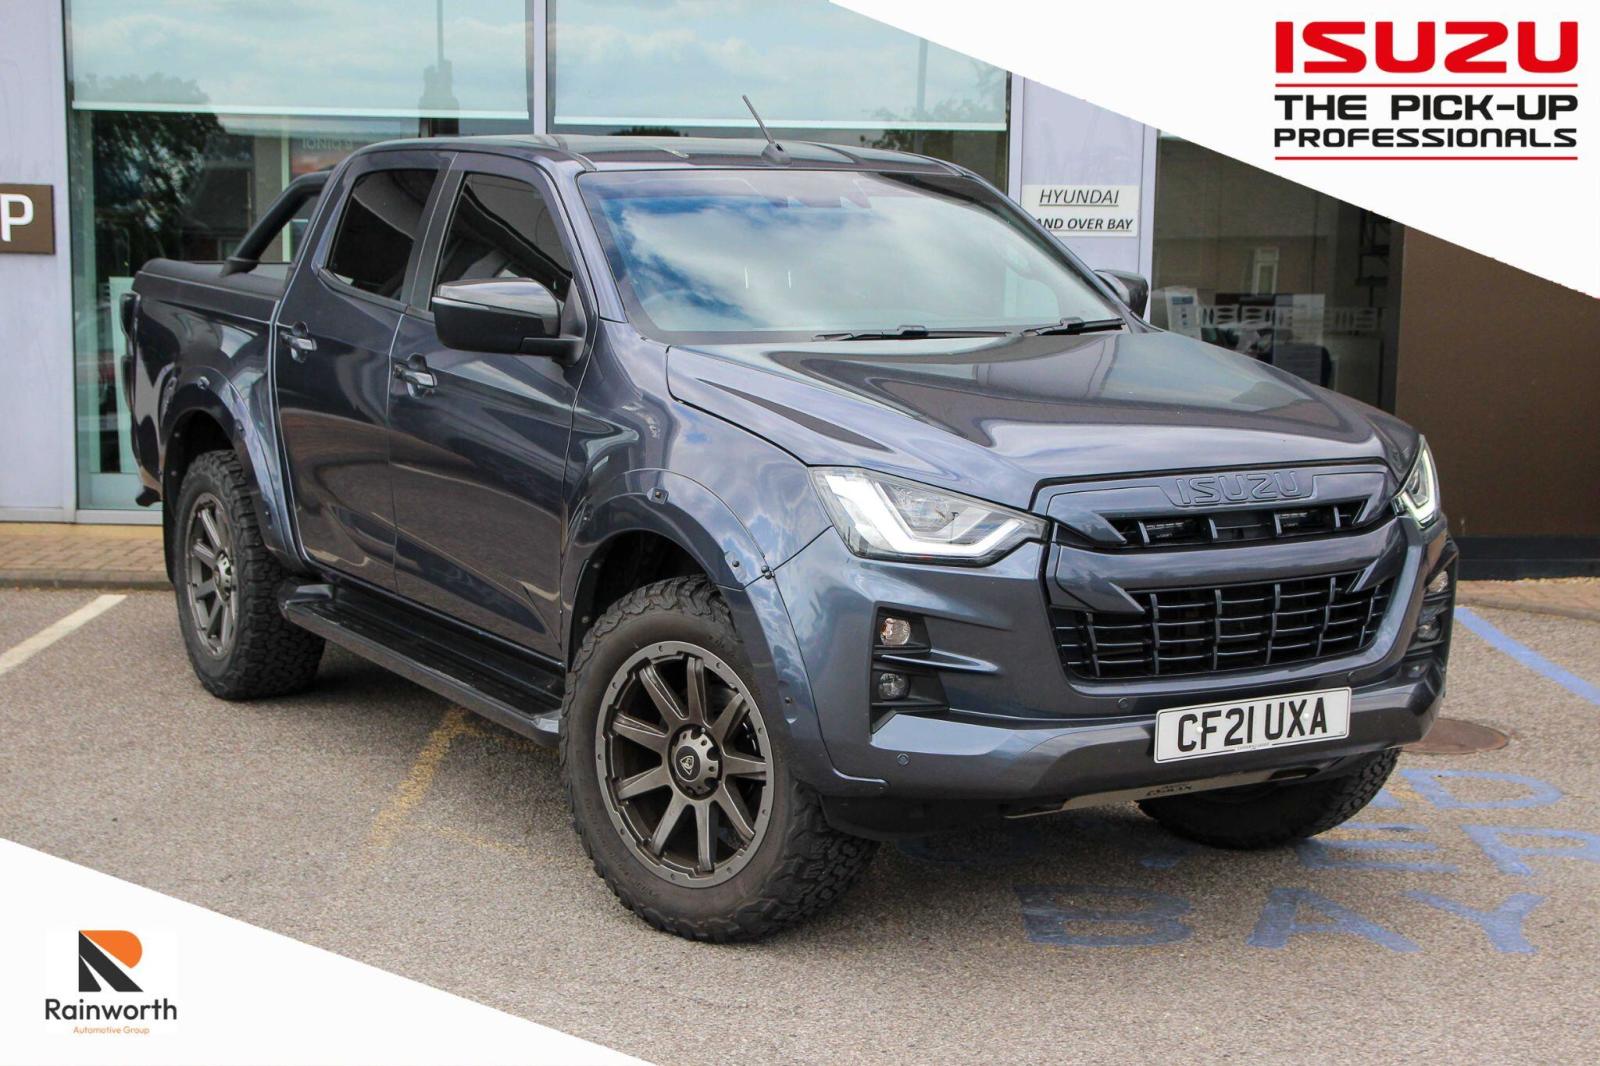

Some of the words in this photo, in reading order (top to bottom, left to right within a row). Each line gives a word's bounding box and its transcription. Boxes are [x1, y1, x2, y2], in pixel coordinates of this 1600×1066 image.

[1039, 188, 1120, 205] HYUNDAI
[1067, 217, 1103, 230] OVER
[1106, 217, 1134, 231] BAY
[1175, 470, 1303, 506] ISUZU
[1176, 705, 1255, 753] CF21
[1263, 696, 1329, 741] UXA
[1014, 882, 1546, 954] BAY
